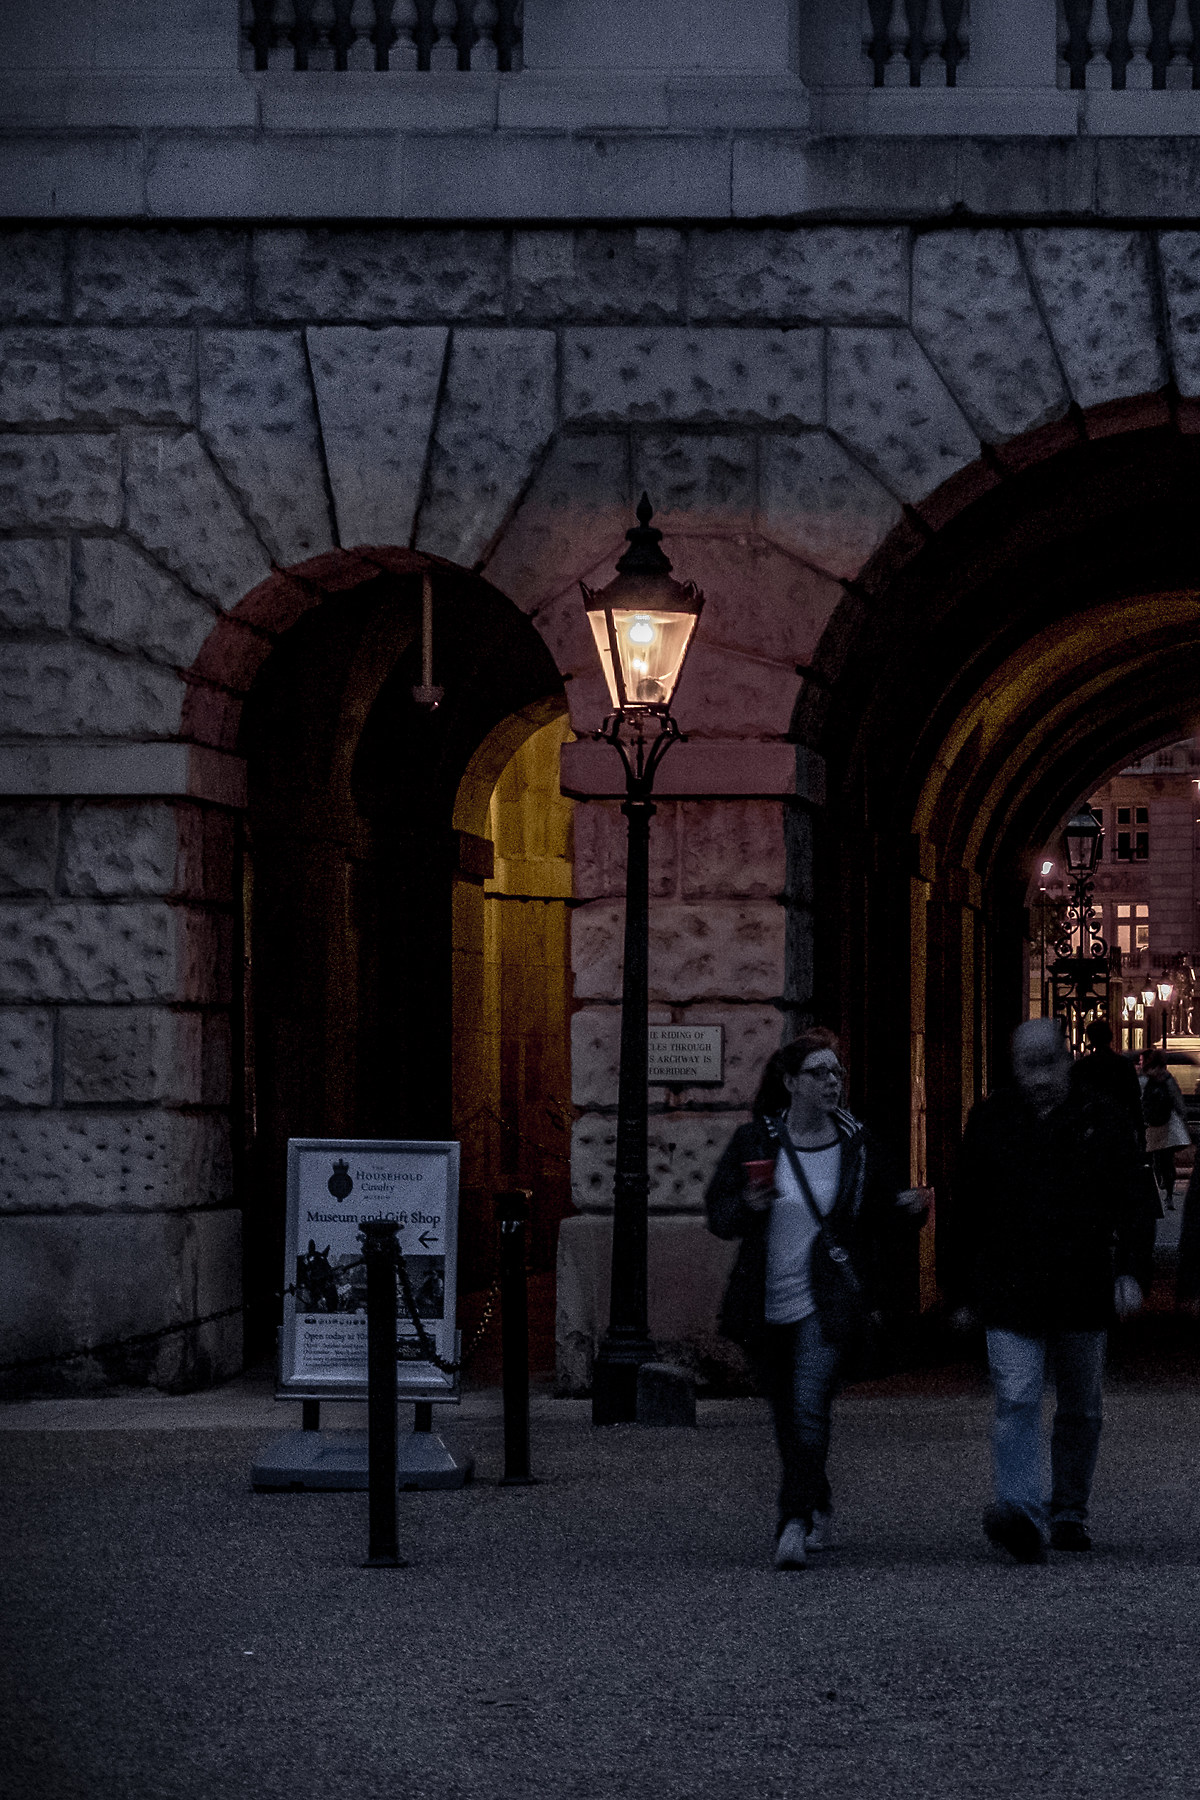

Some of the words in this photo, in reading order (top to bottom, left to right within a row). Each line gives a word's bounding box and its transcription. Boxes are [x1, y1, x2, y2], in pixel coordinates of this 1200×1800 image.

[356, 1171, 423, 1181] HOUSEHOLD
[361, 1182, 395, 1193] Cavalry
[307, 1211, 358, 1223] Museum
[360, 1210, 382, 1222] and
[385, 1211, 408, 1223] Gift
[411, 1211, 441, 1228] Shop
